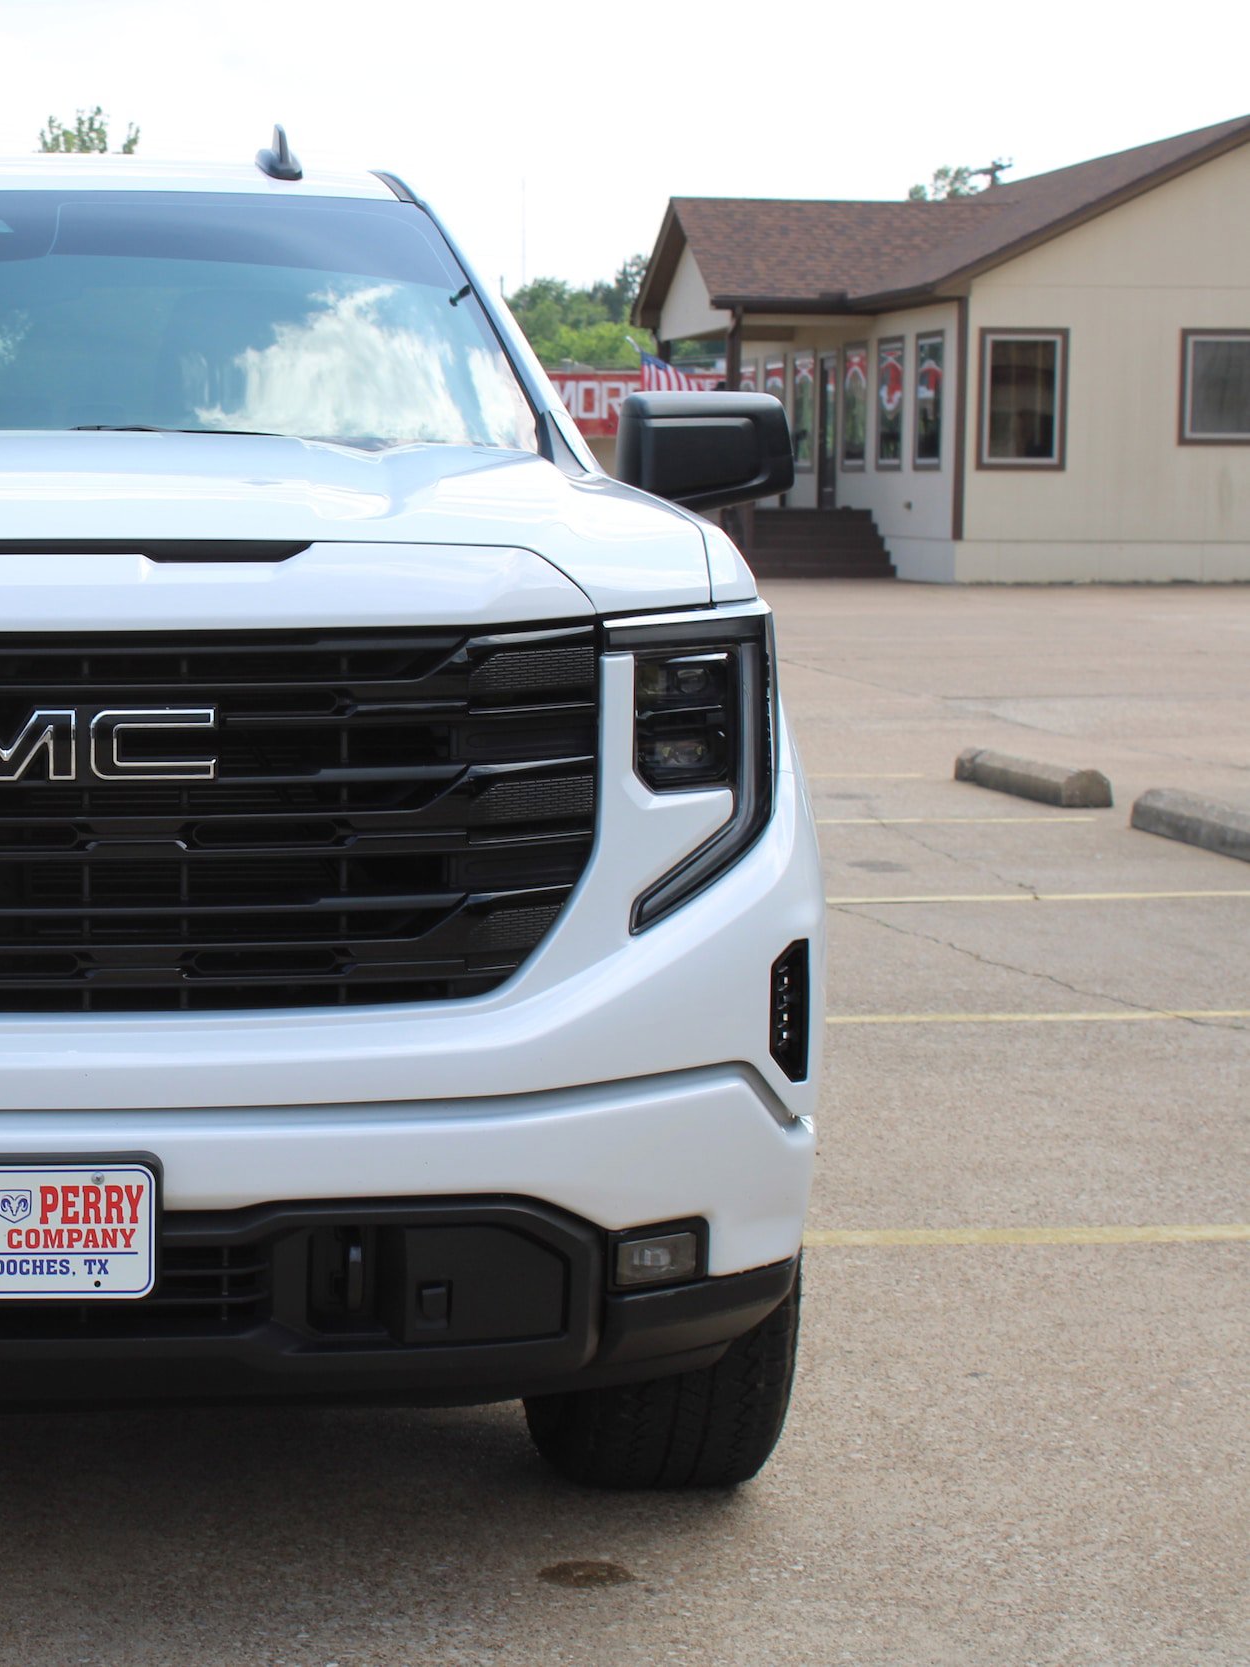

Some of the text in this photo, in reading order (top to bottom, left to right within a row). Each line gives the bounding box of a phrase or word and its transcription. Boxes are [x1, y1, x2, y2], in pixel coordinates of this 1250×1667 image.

[39, 1185, 144, 1224] PERRY
[7, 1228, 136, 1249] COMPANY
[84, 1259, 109, 1275] TX
